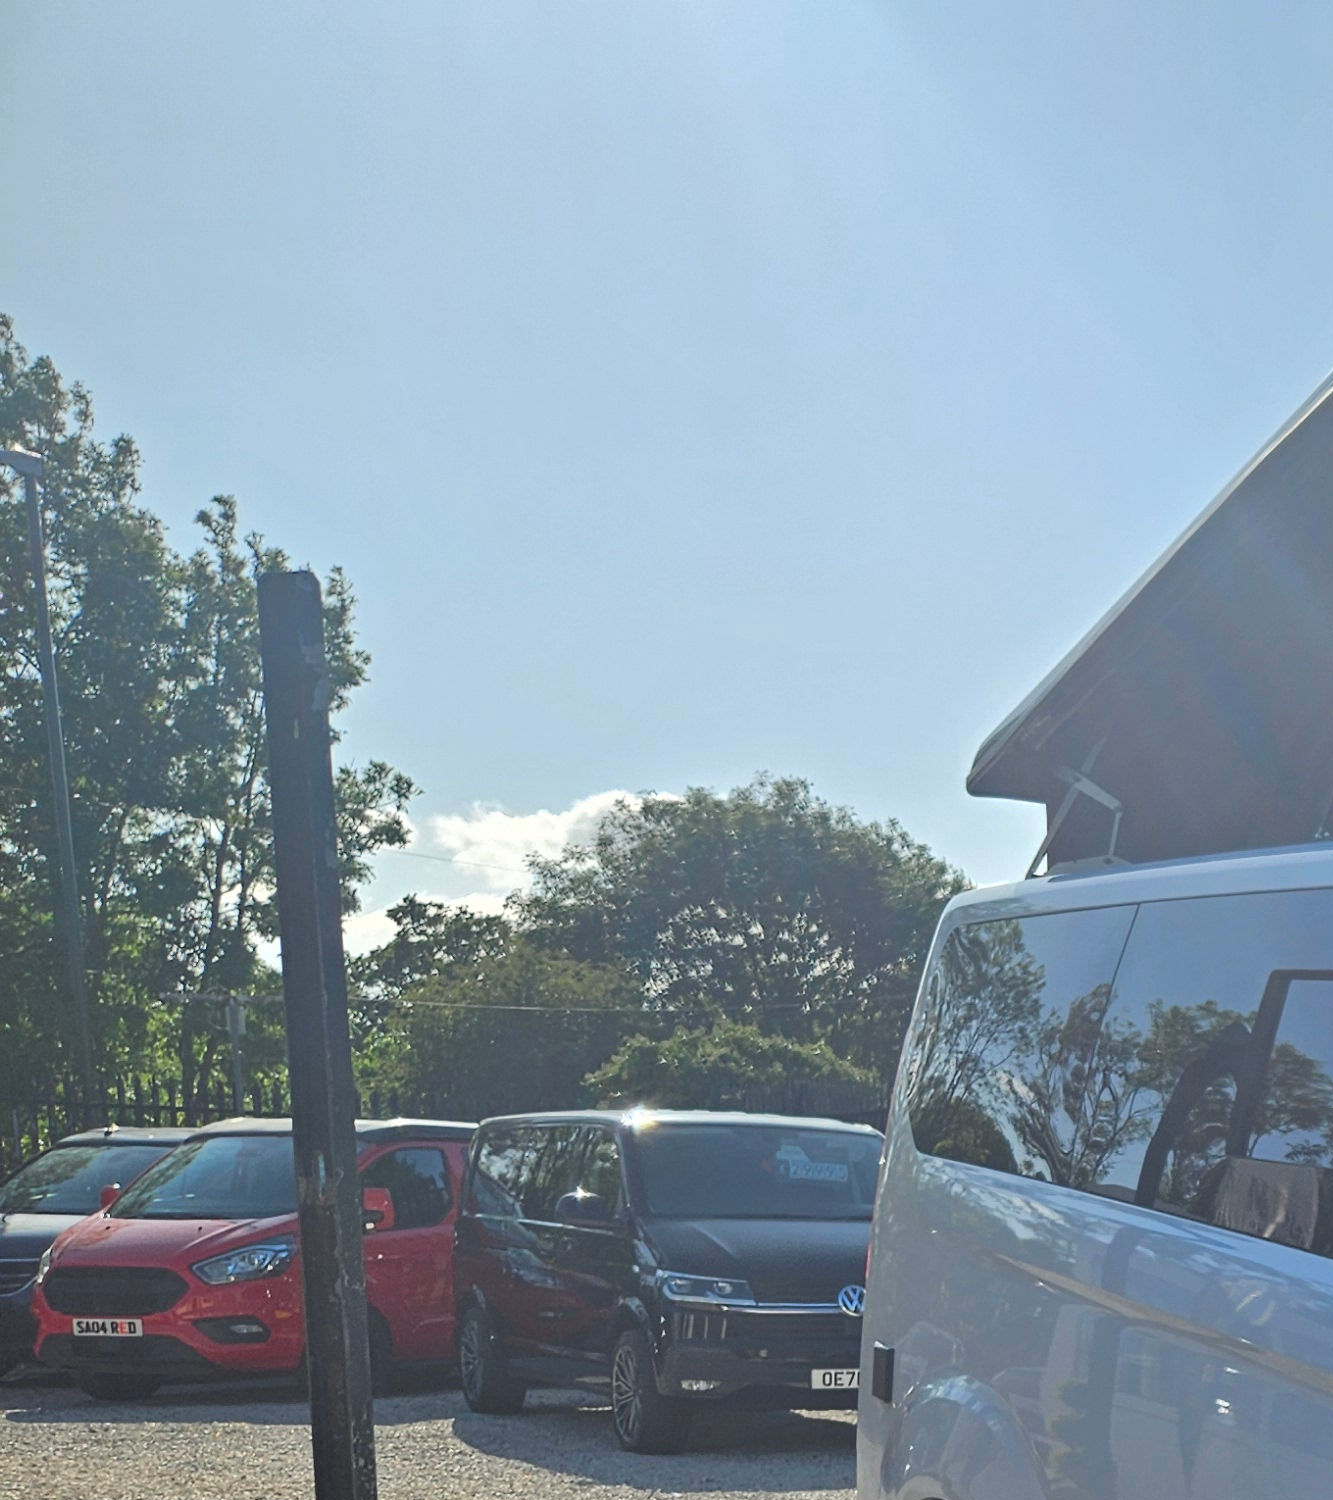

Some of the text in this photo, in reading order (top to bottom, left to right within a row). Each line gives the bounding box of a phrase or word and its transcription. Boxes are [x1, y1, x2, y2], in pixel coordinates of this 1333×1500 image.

[76, 1321, 137, 1334] SA04 RED
[822, 1371, 860, 1387] OE7
